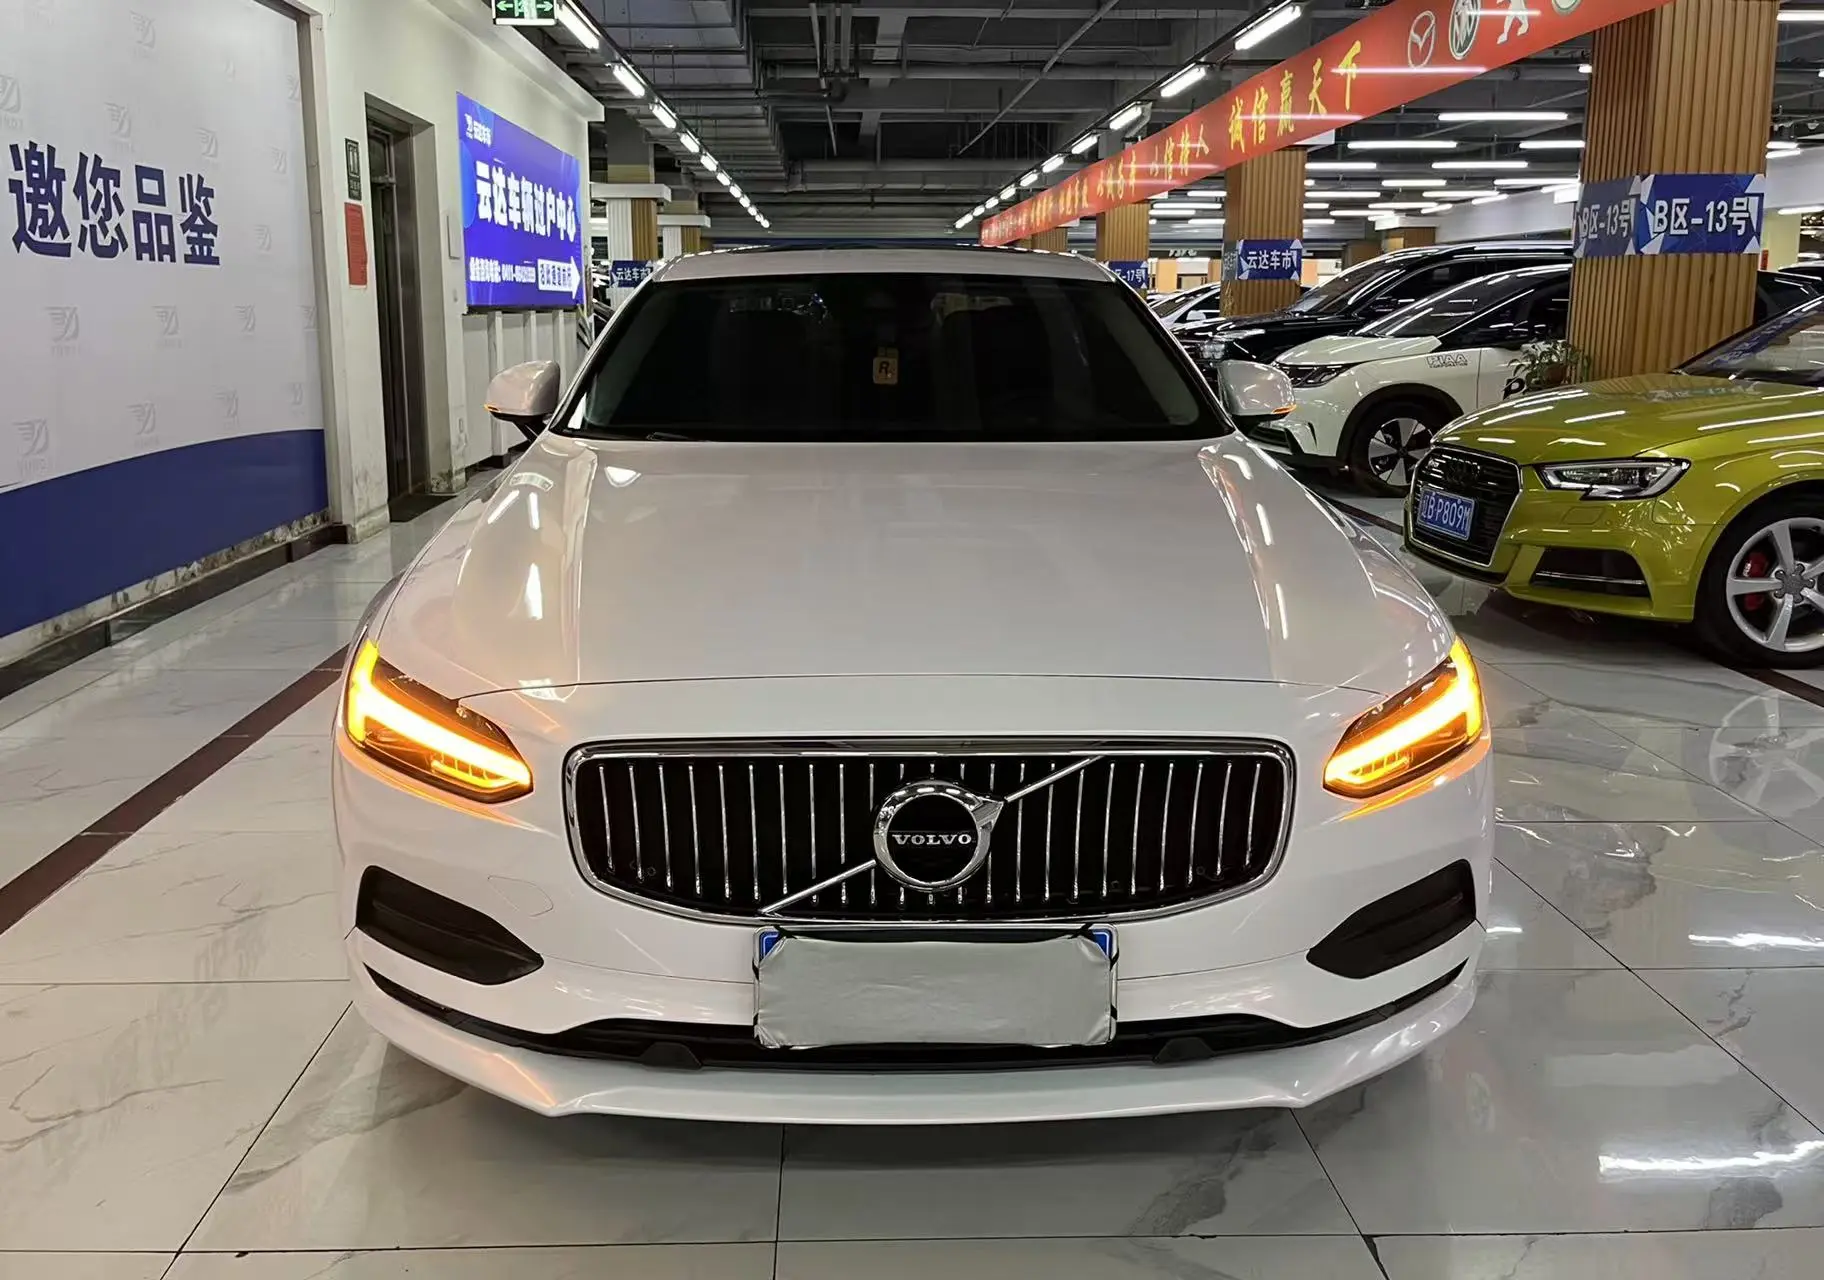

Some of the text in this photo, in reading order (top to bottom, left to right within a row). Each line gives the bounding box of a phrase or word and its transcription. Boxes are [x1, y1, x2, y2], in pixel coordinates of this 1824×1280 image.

[8, 140, 220, 265] 邀您品鉴
[476, 160, 576, 242] 云达车辆过户中心
[1580, 200, 1632, 240] B区-13号
[1653, 197, 1750, 236] B区-13号
[1247, 250, 1292, 270] 云达车市
[1427, 353, 1468, 365] PIAA
[891, 834, 972, 845] VOLVO
